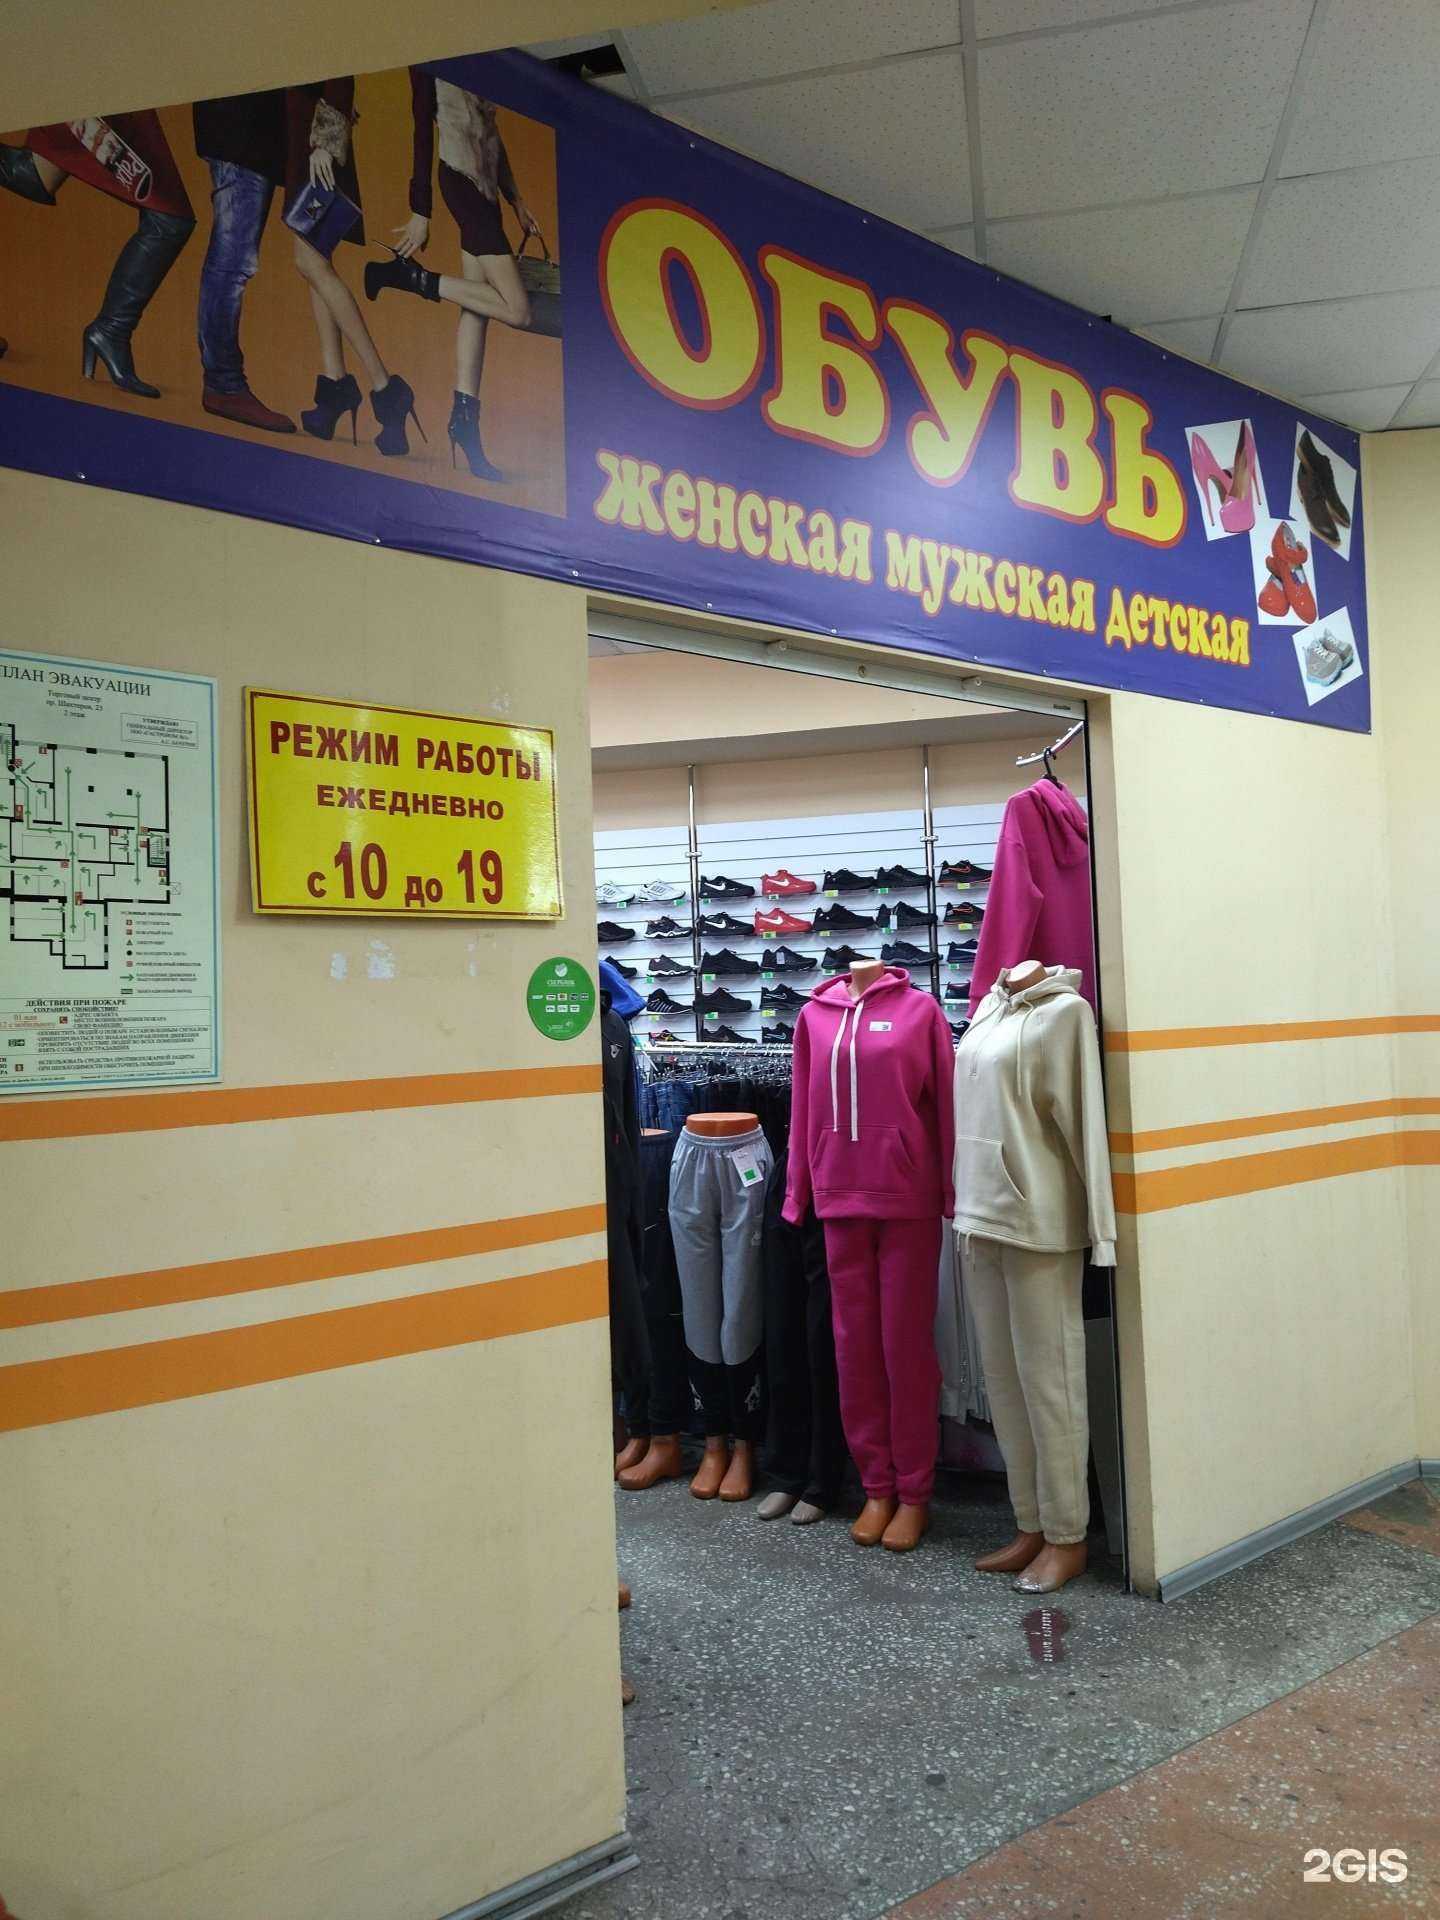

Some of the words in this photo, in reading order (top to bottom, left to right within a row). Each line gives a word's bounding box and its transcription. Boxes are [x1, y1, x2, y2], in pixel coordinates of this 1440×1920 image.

[600, 198, 1187, 548] ОБУВЬ
[595, 448, 873, 583] женская
[885, 528, 1096, 633] мужская
[1104, 585, 1251, 666] детская
[0, 665, 44, 683] ПЛАН
[48, 672, 152, 697] ЭВАКУАЦИИ
[270, 721, 400, 767] РЕЖИМ
[417, 738, 542, 782] РАБОТЫ
[317, 784, 505, 821] ЕЖЕДНЕВНО
[334, 841, 388, 901] 10
[404, 876, 443, 908] до
[457, 849, 504, 905] 19
[25, 998, 71, 1007] ДЕЙСТВИЯ
